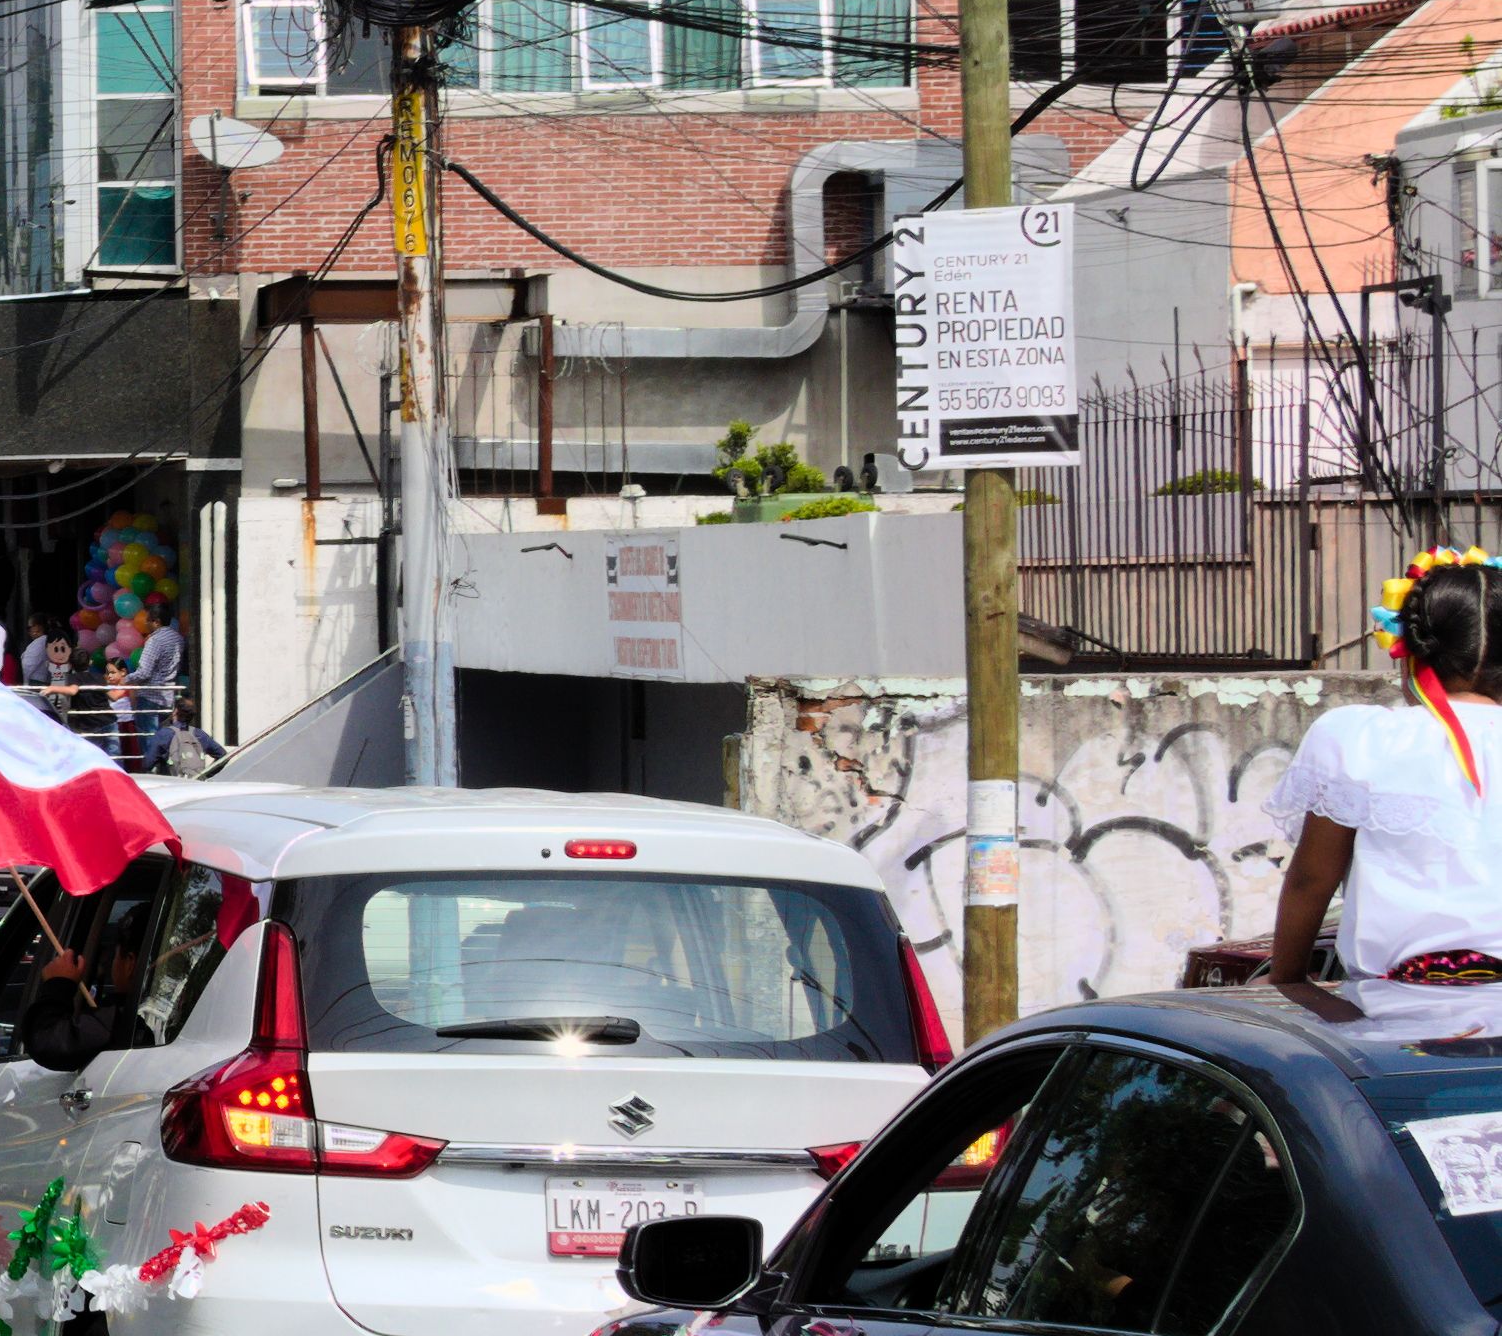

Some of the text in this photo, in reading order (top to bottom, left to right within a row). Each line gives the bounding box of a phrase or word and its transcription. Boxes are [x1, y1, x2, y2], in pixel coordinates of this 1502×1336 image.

[934, 253, 1028, 268] CENTURY 21
[936, 290, 1018, 315] RENTA
[937, 316, 1065, 343] PROPIEDAD
[895, 261, 929, 471] CENTURY
[937, 346, 1065, 369] EN ESTA ZONA
[939, 384, 1065, 411] 55 5673 9093
[329, 1225, 413, 1241] SUZUKI
